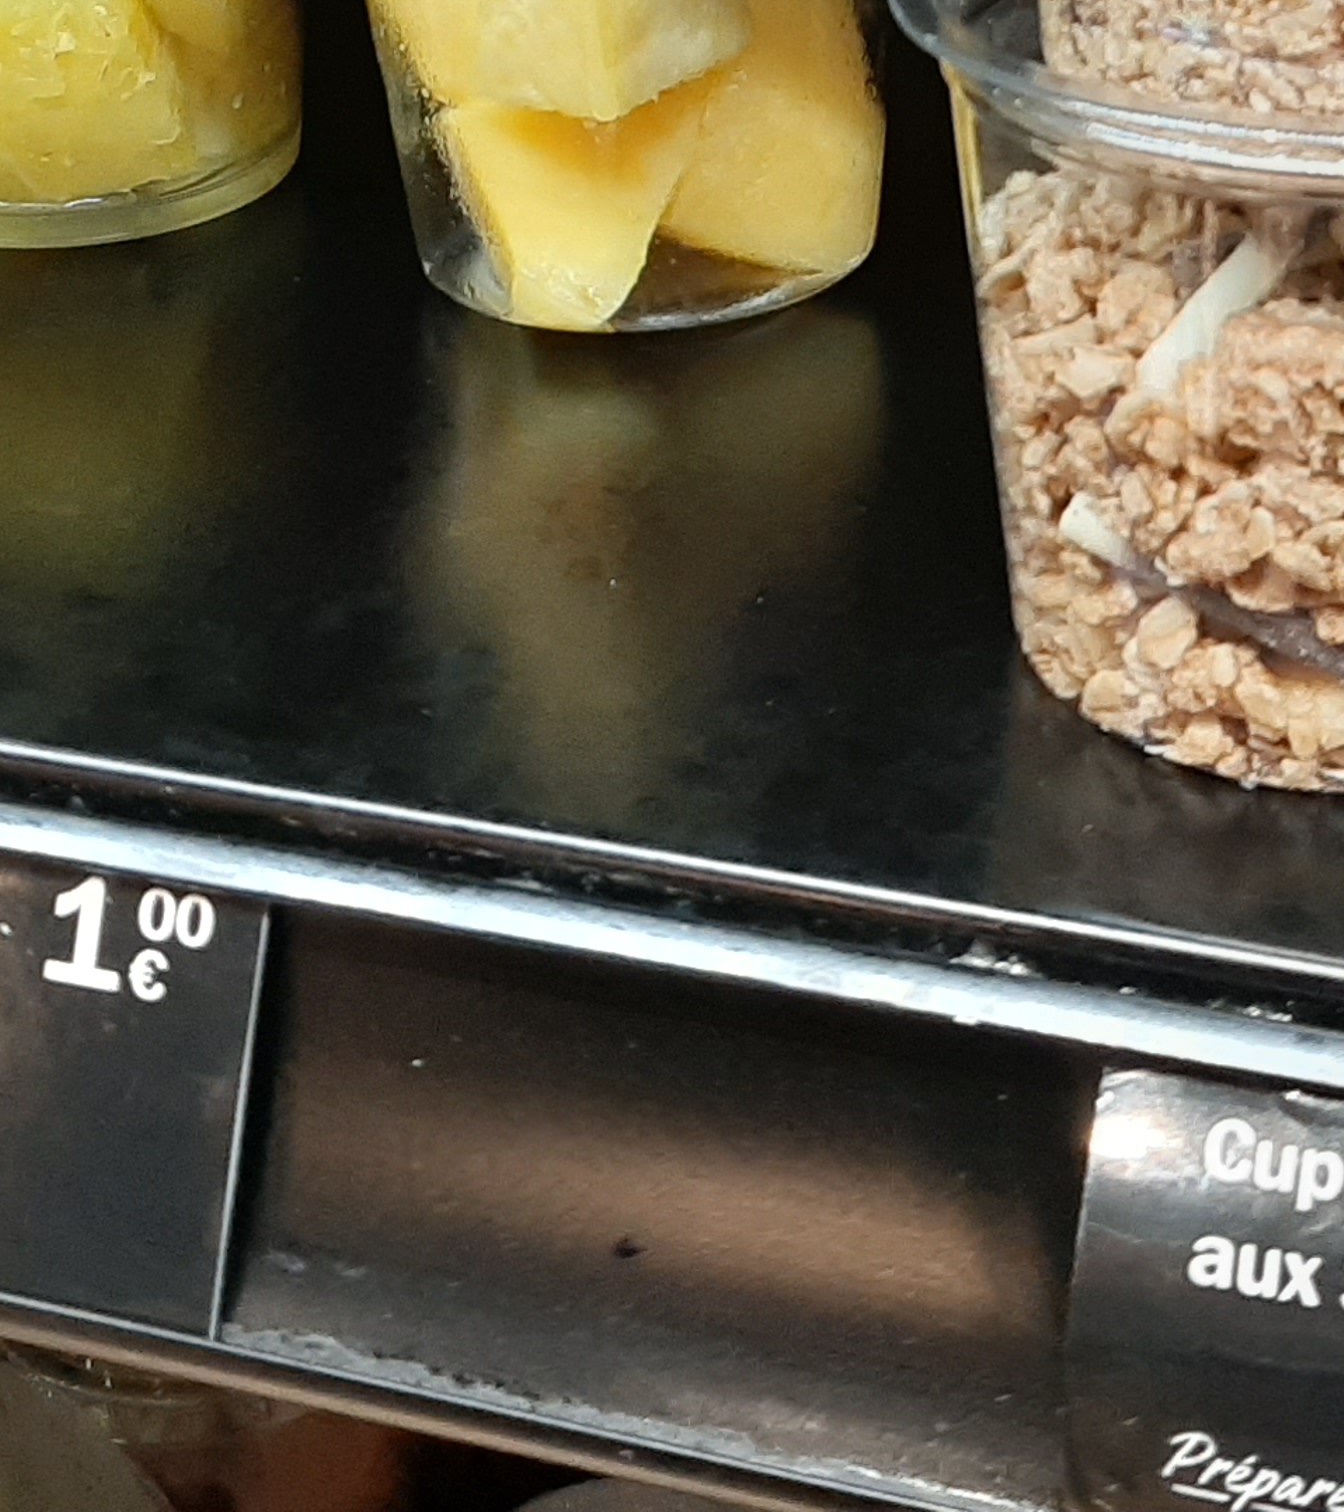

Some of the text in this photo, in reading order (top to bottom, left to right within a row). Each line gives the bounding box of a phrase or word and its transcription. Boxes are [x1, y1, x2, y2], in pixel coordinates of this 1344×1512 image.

[42, 875, 217, 1002] 1 00 €
[1204, 1117, 1344, 1210] Cup
[1187, 1234, 1324, 1308] aux
